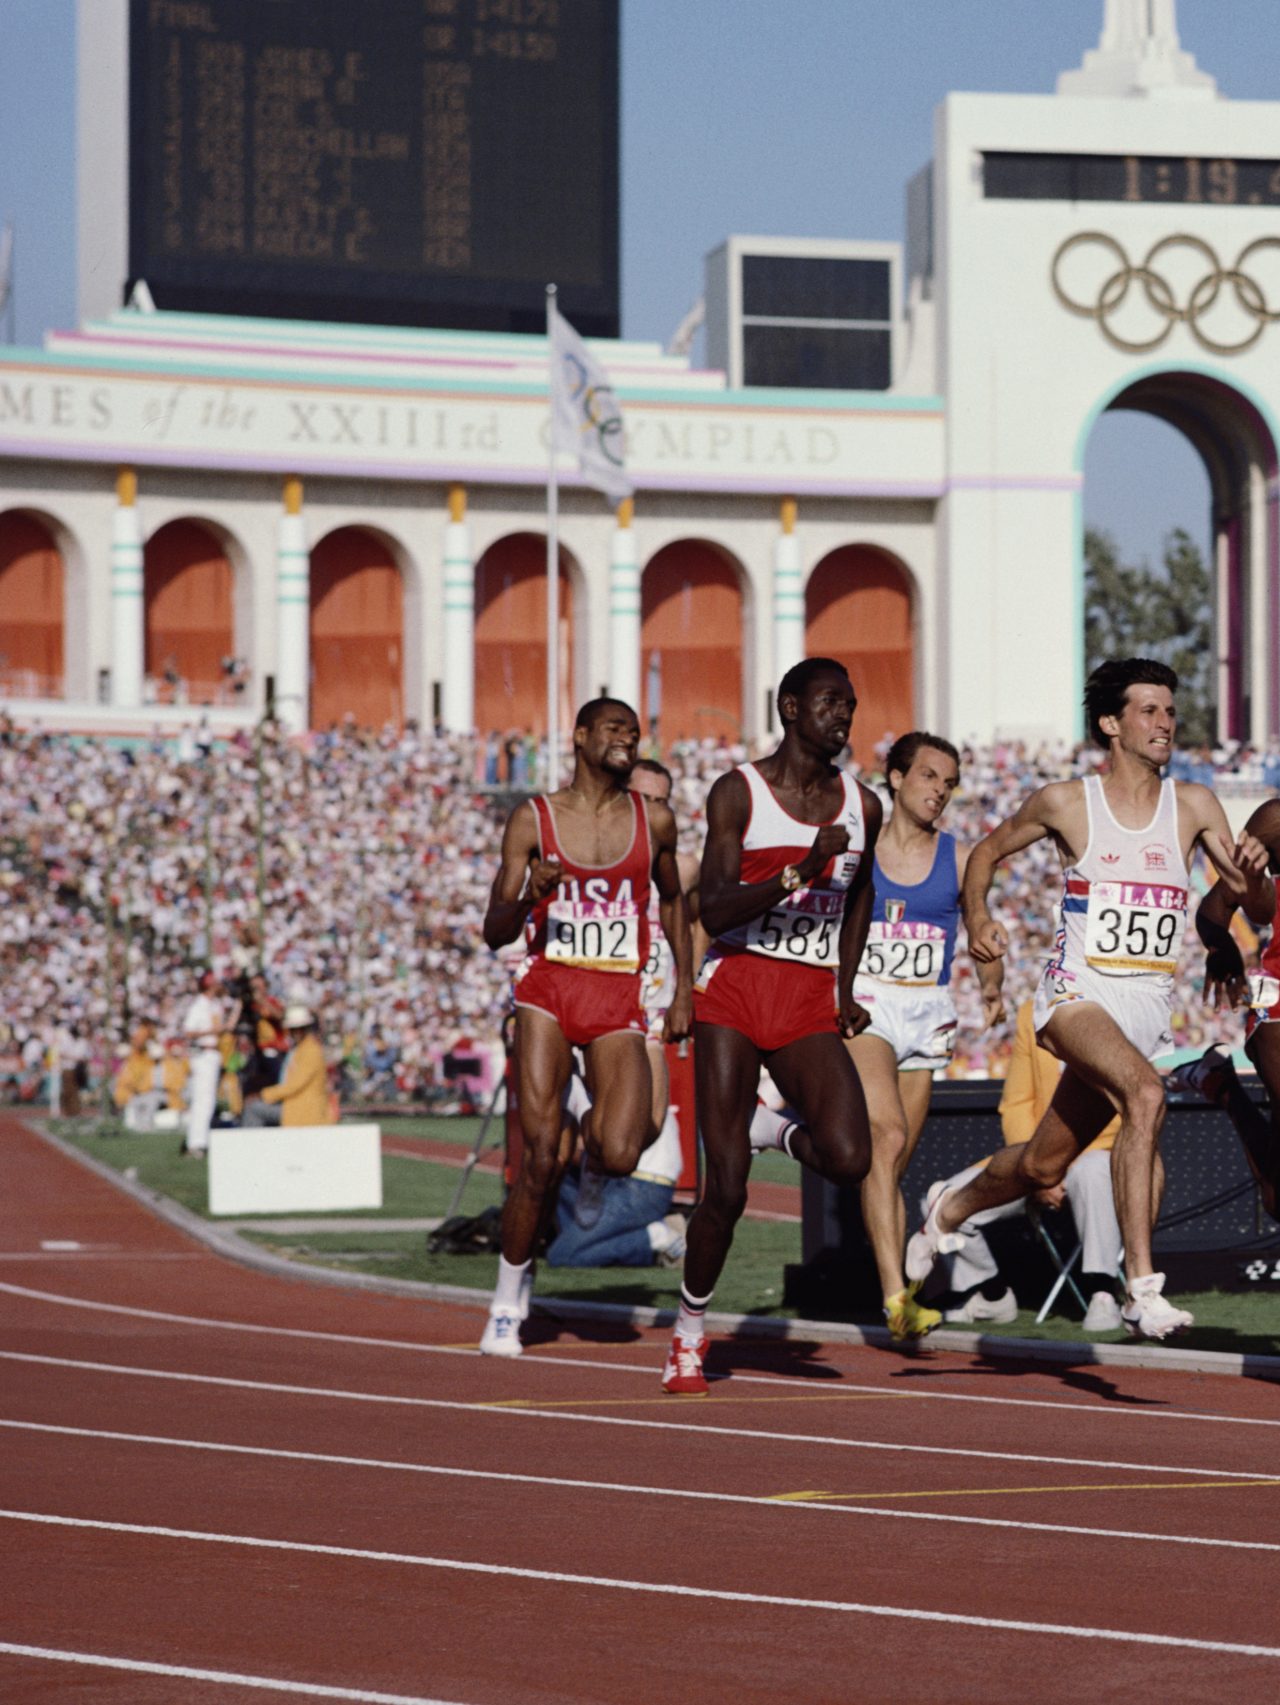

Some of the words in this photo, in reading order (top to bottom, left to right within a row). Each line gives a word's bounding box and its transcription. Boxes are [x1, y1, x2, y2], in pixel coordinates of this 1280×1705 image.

[557, 878, 632, 904] USA
[556, 921, 627, 957] 902
[1096, 908, 1177, 957] 359
[866, 942, 933, 978] 520
